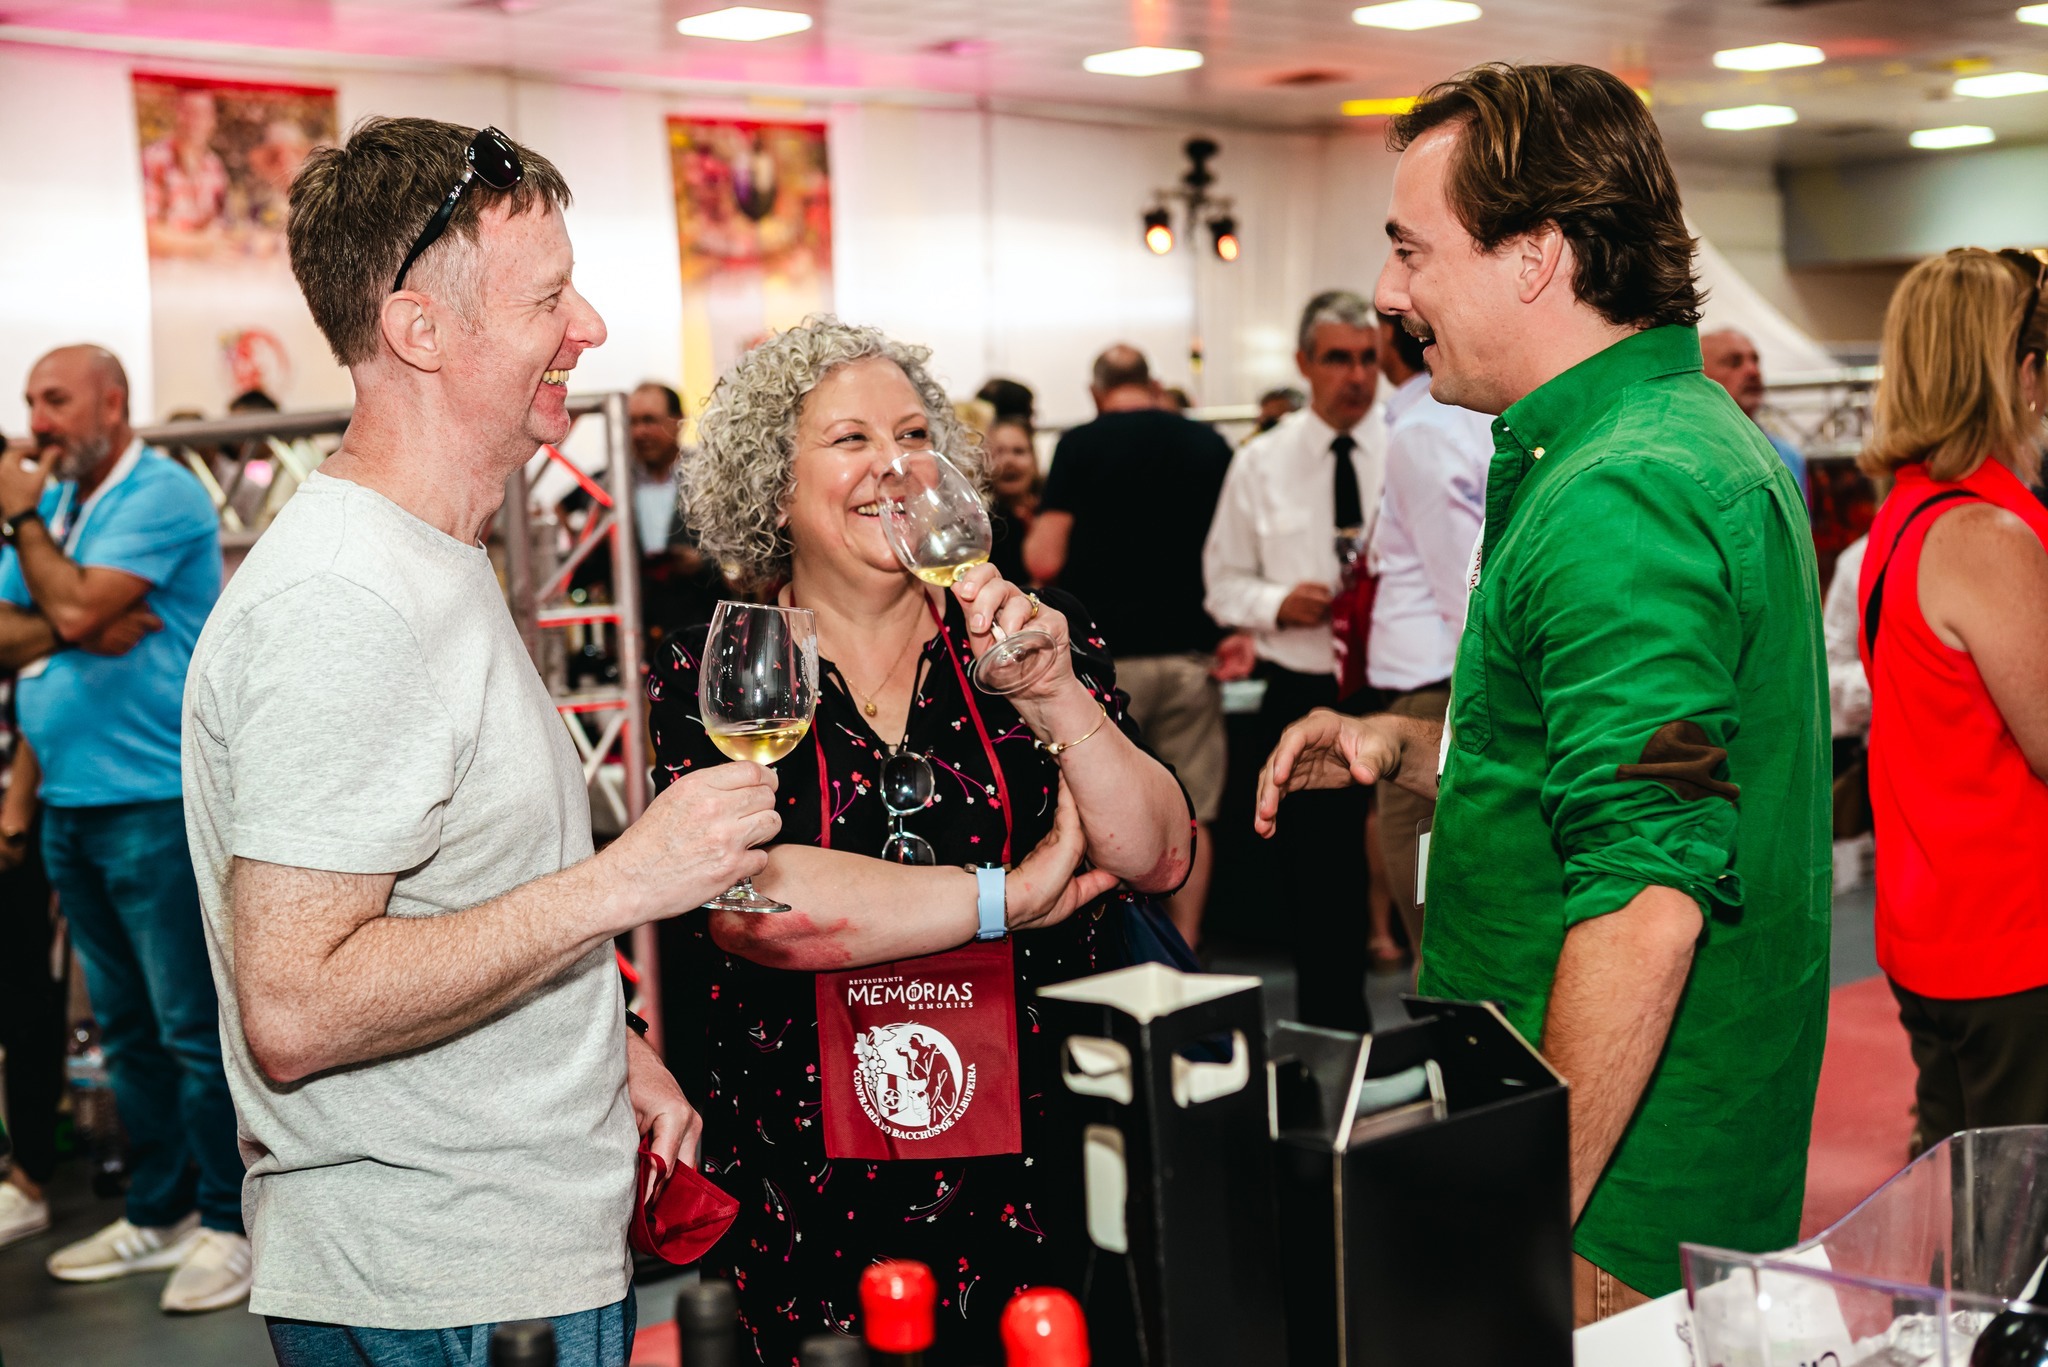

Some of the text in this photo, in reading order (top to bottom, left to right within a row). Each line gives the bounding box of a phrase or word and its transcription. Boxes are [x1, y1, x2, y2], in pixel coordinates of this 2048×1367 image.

[849, 976, 904, 985] RESTAURANTE
[848, 979, 973, 1006] MEMÓRIAS
[908, 1001, 974, 1010] MEMORIES
[853, 1069, 881, 1127] CONFRARIA
[891, 1124, 943, 1140] BACCHUS
[940, 1118, 955, 1132] DE
[952, 1062, 977, 1121] ALBUFEIRA
